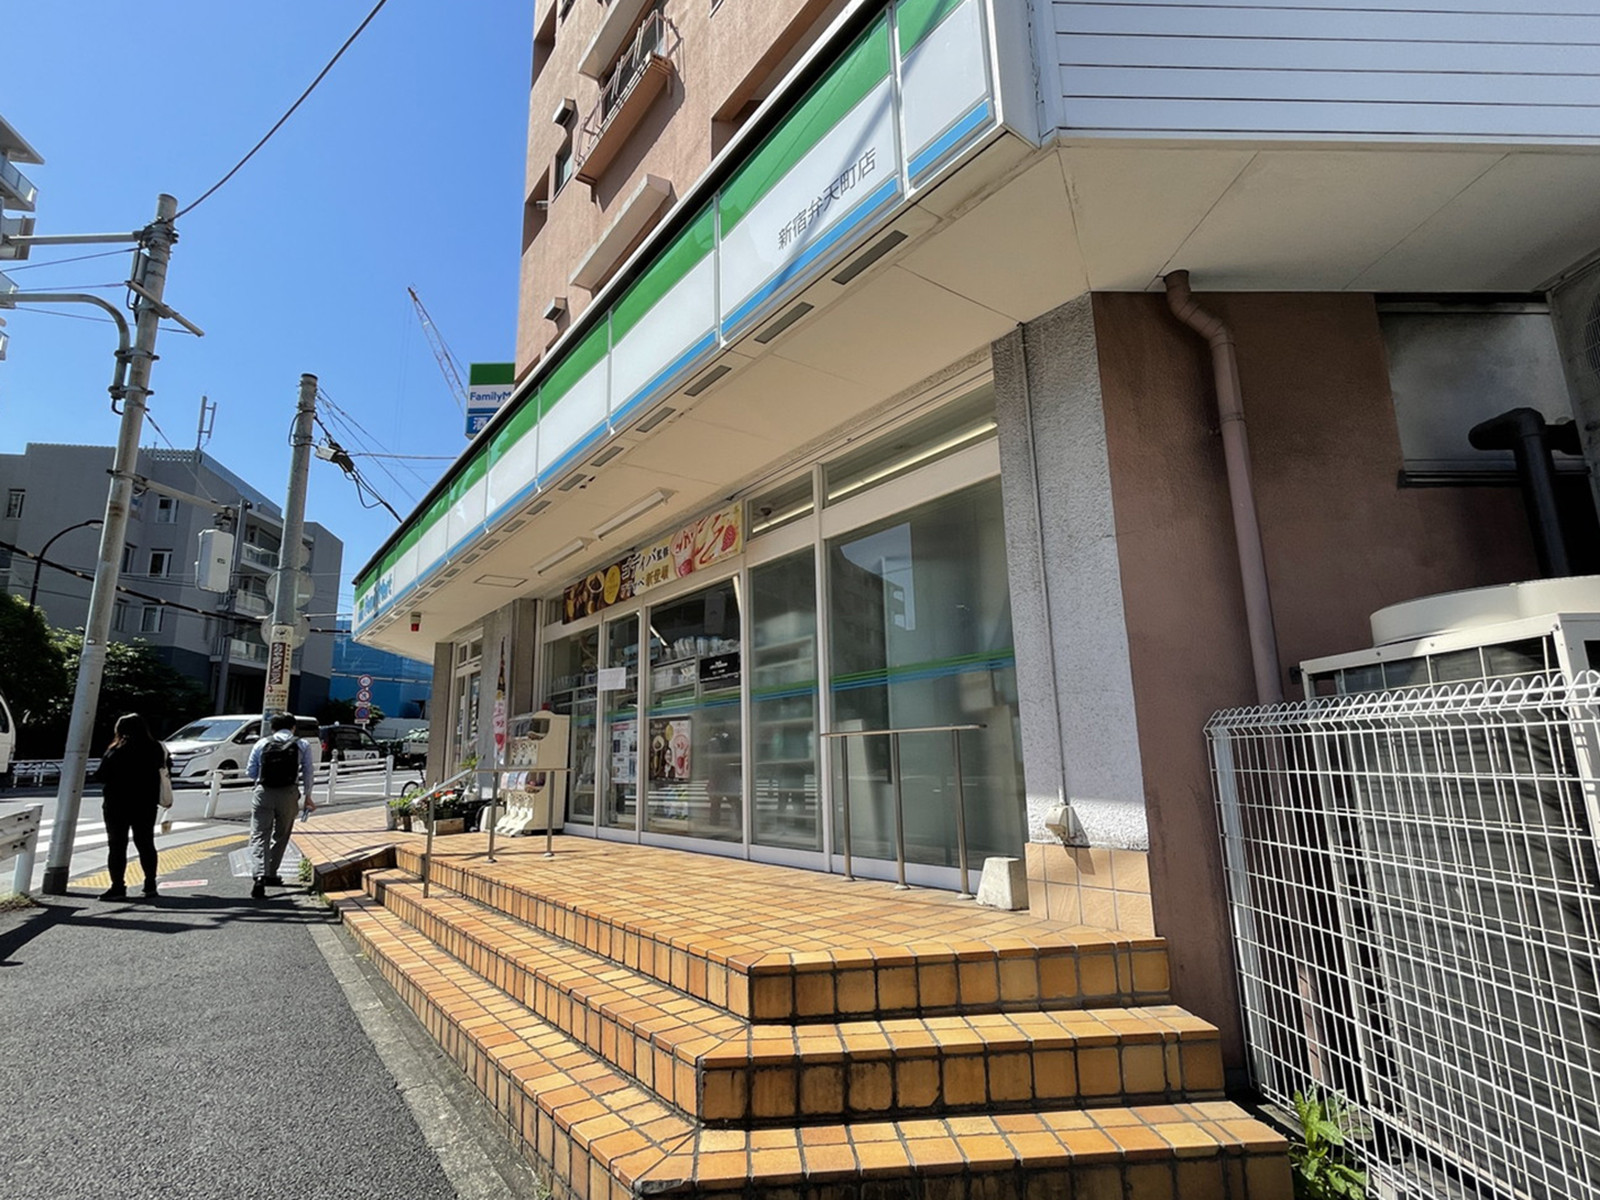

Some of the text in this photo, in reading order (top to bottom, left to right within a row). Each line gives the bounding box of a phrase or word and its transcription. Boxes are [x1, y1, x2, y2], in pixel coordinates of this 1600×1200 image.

[778, 147, 876, 250] 新宿弁天町店
